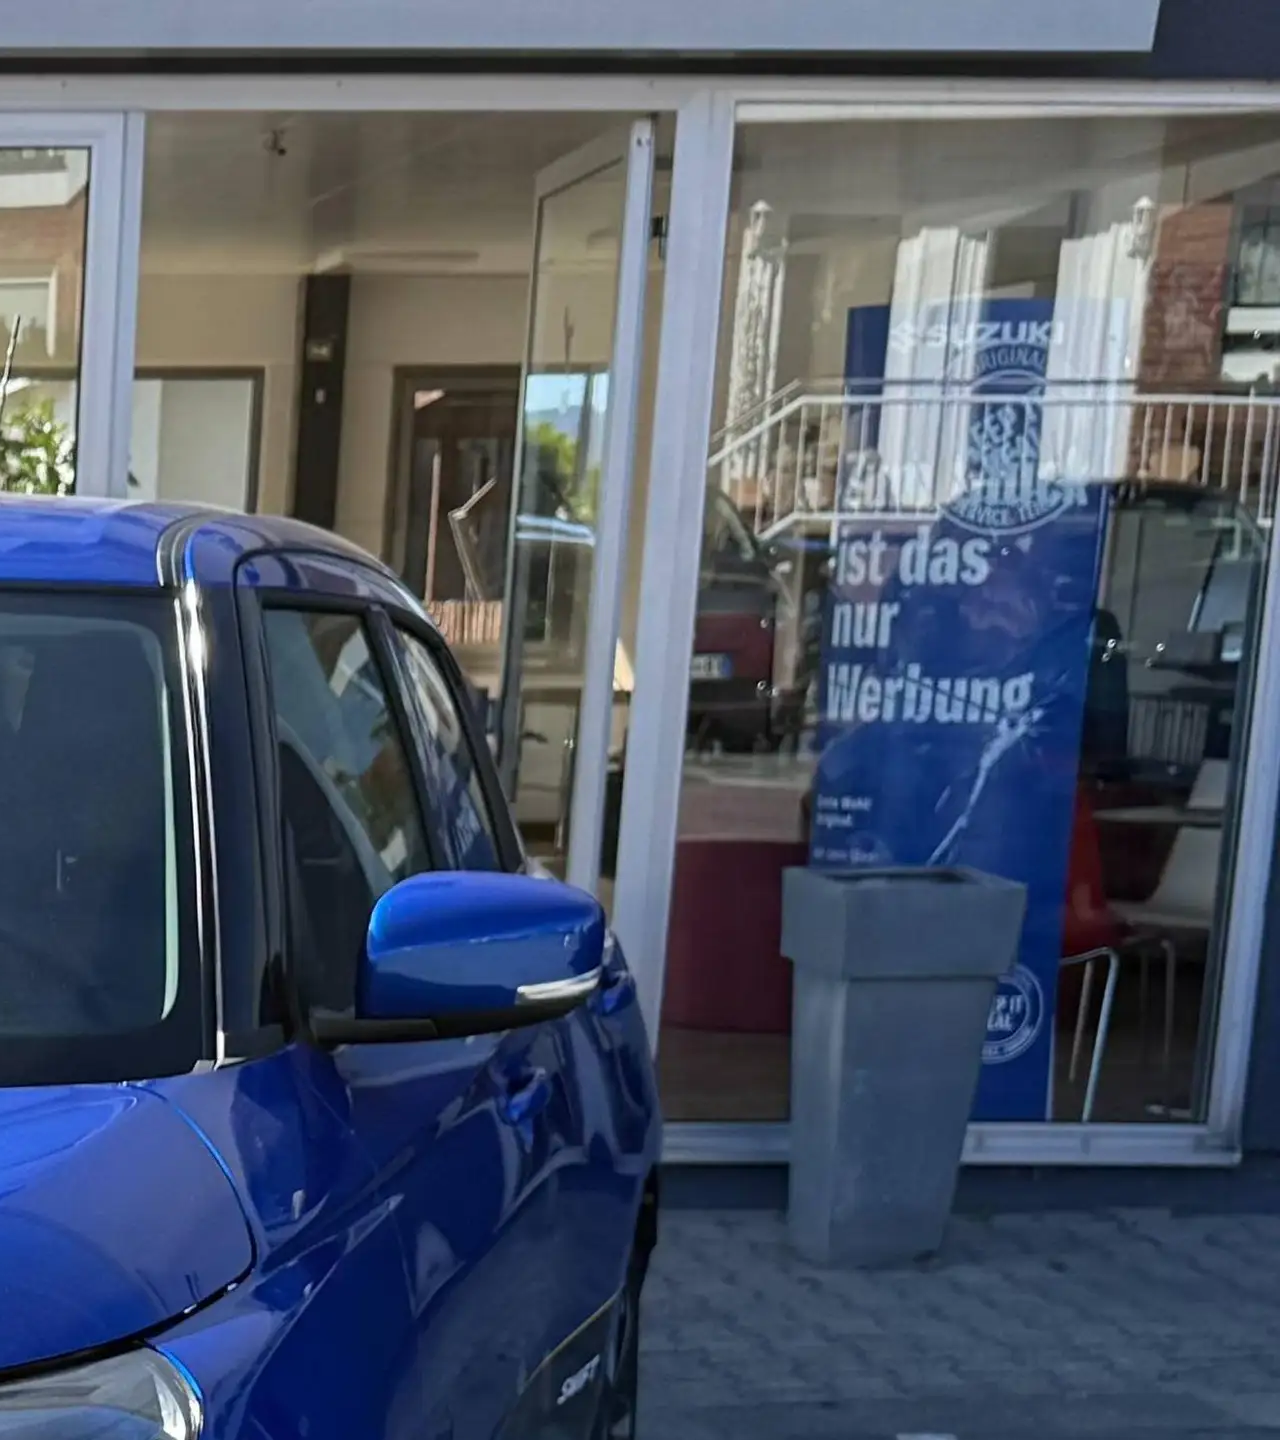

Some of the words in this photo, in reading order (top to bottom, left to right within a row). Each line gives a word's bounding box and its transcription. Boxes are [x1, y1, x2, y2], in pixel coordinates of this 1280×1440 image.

[837, 527, 888, 586] ist
[899, 525, 991, 586] das
[831, 601, 901, 648] nur
